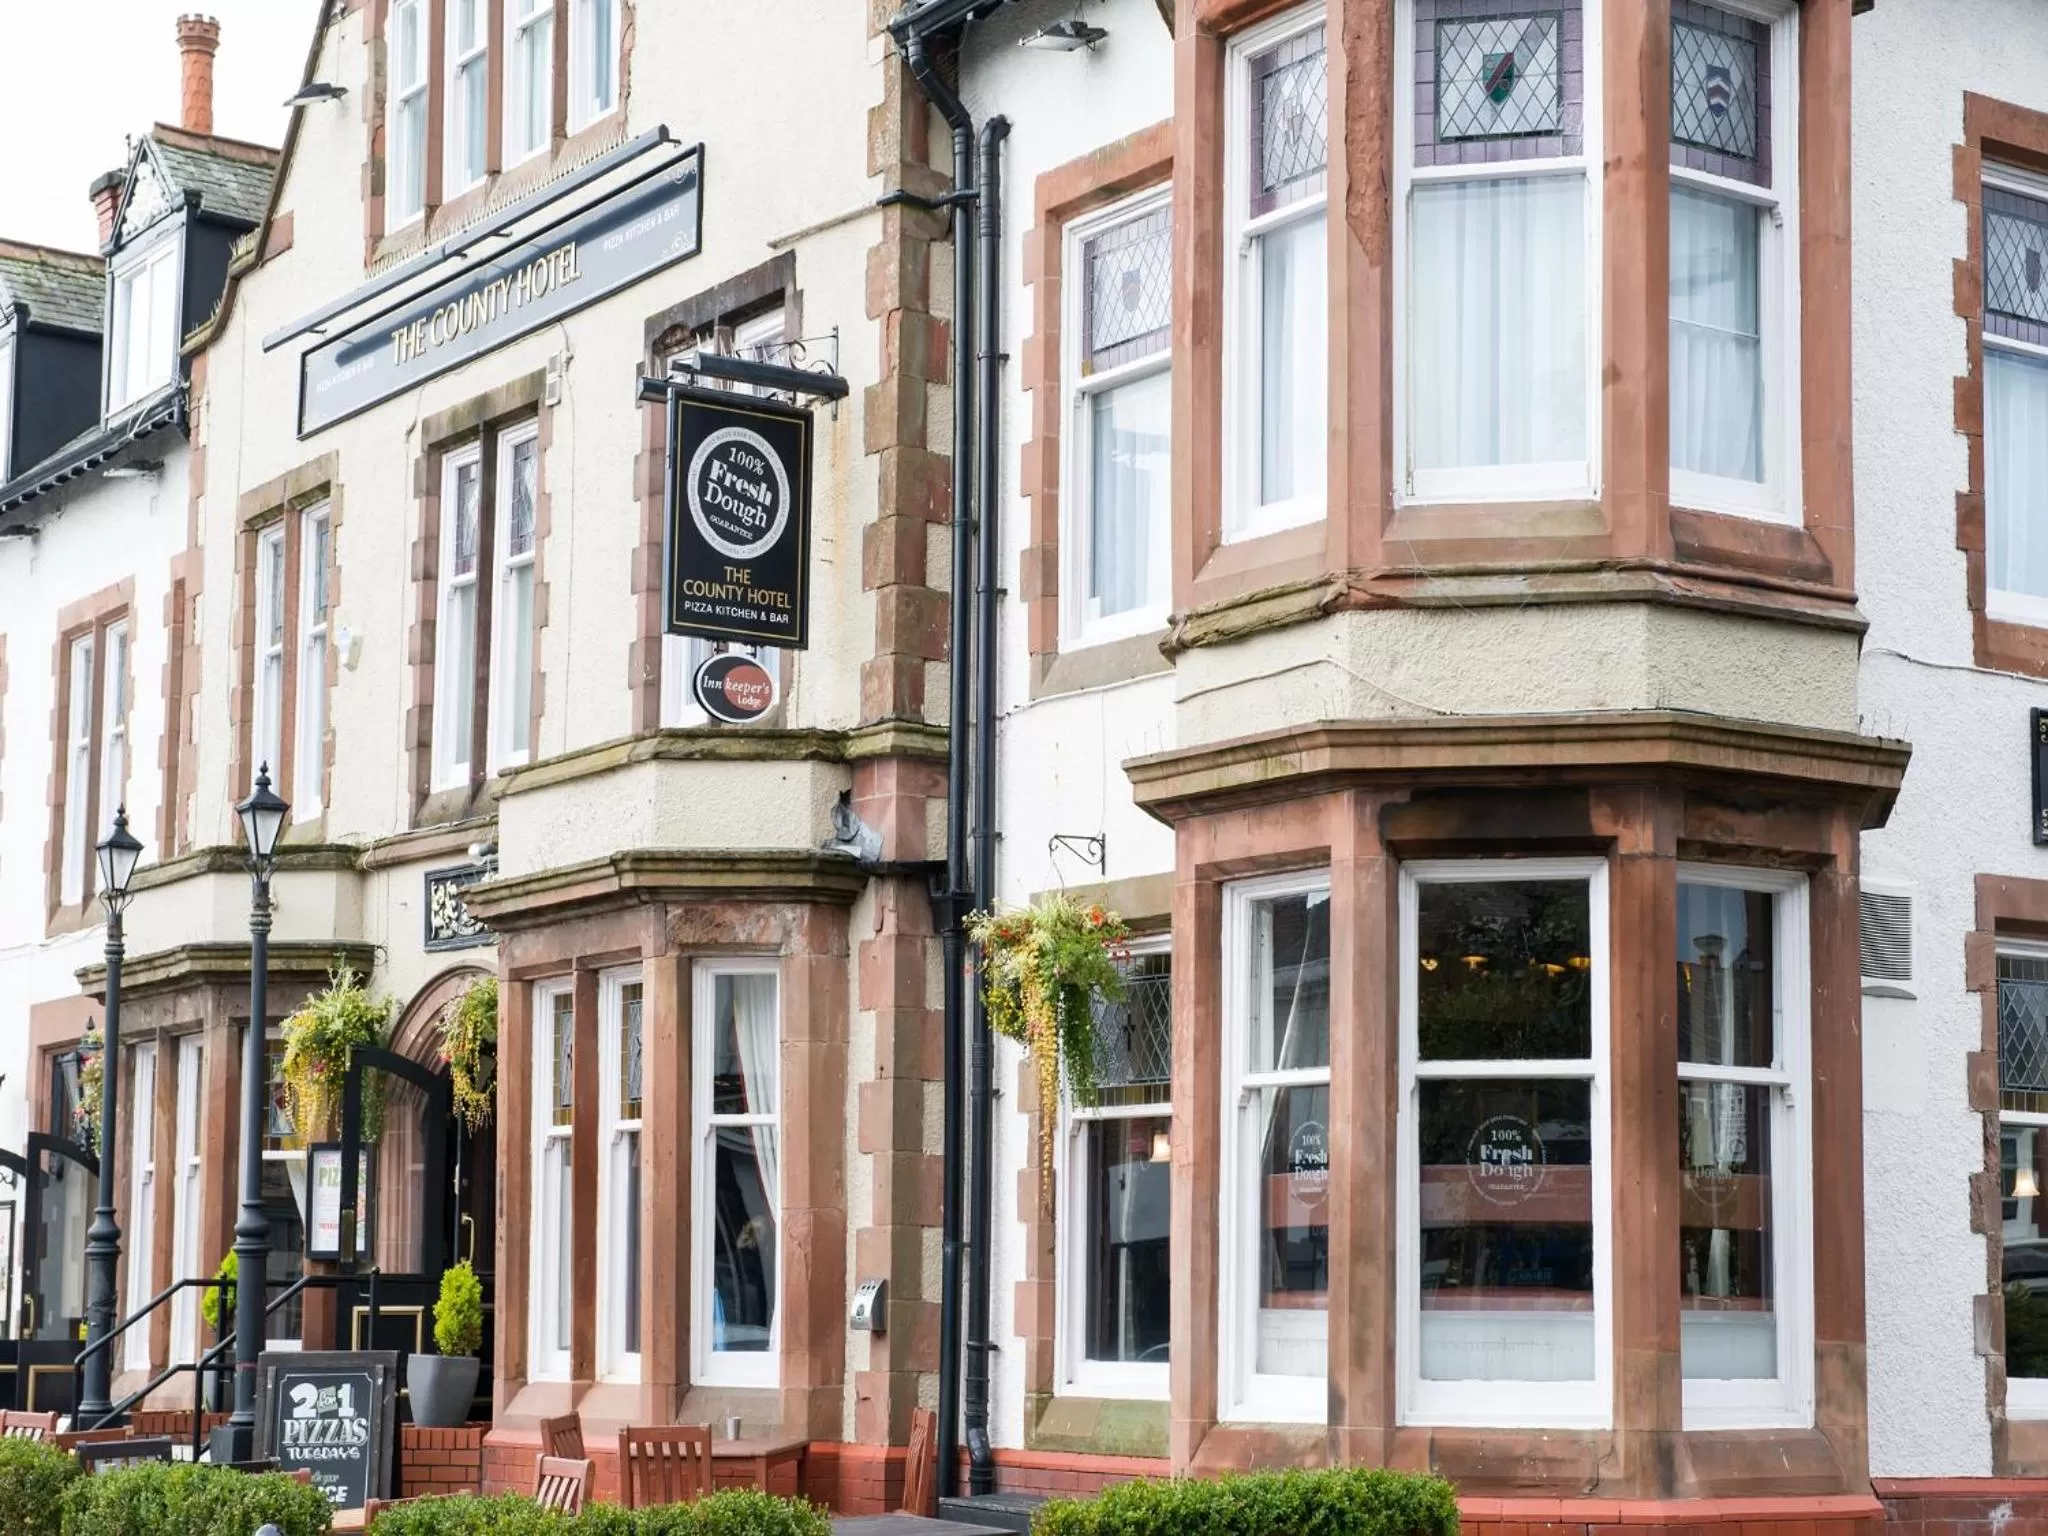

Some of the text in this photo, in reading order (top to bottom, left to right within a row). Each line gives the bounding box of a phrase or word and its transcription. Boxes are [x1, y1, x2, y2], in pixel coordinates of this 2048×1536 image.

[664, 204, 680, 223] BAR
[392, 241, 583, 366] THE COUNTY HOTEL
[728, 447, 766, 476] 100%
[709, 458, 773, 507] Fresh
[703, 479, 768, 528] Dough
[709, 514, 753, 540] GUARANTEE
[723, 565, 752, 585] THE
[683, 579, 792, 609] COUNTY HOTEL
[684, 600, 790, 624] PIZZA KITCHEN & BAR
[703, 675, 770, 696] Inn keeper's
[1491, 1129, 1522, 1141] 100%
[1480, 1144, 1533, 1161] Fresh
[289, 1382, 319, 1418] 2
[337, 1383, 355, 1417] 1
[282, 1417, 369, 1447] PIZZAS
